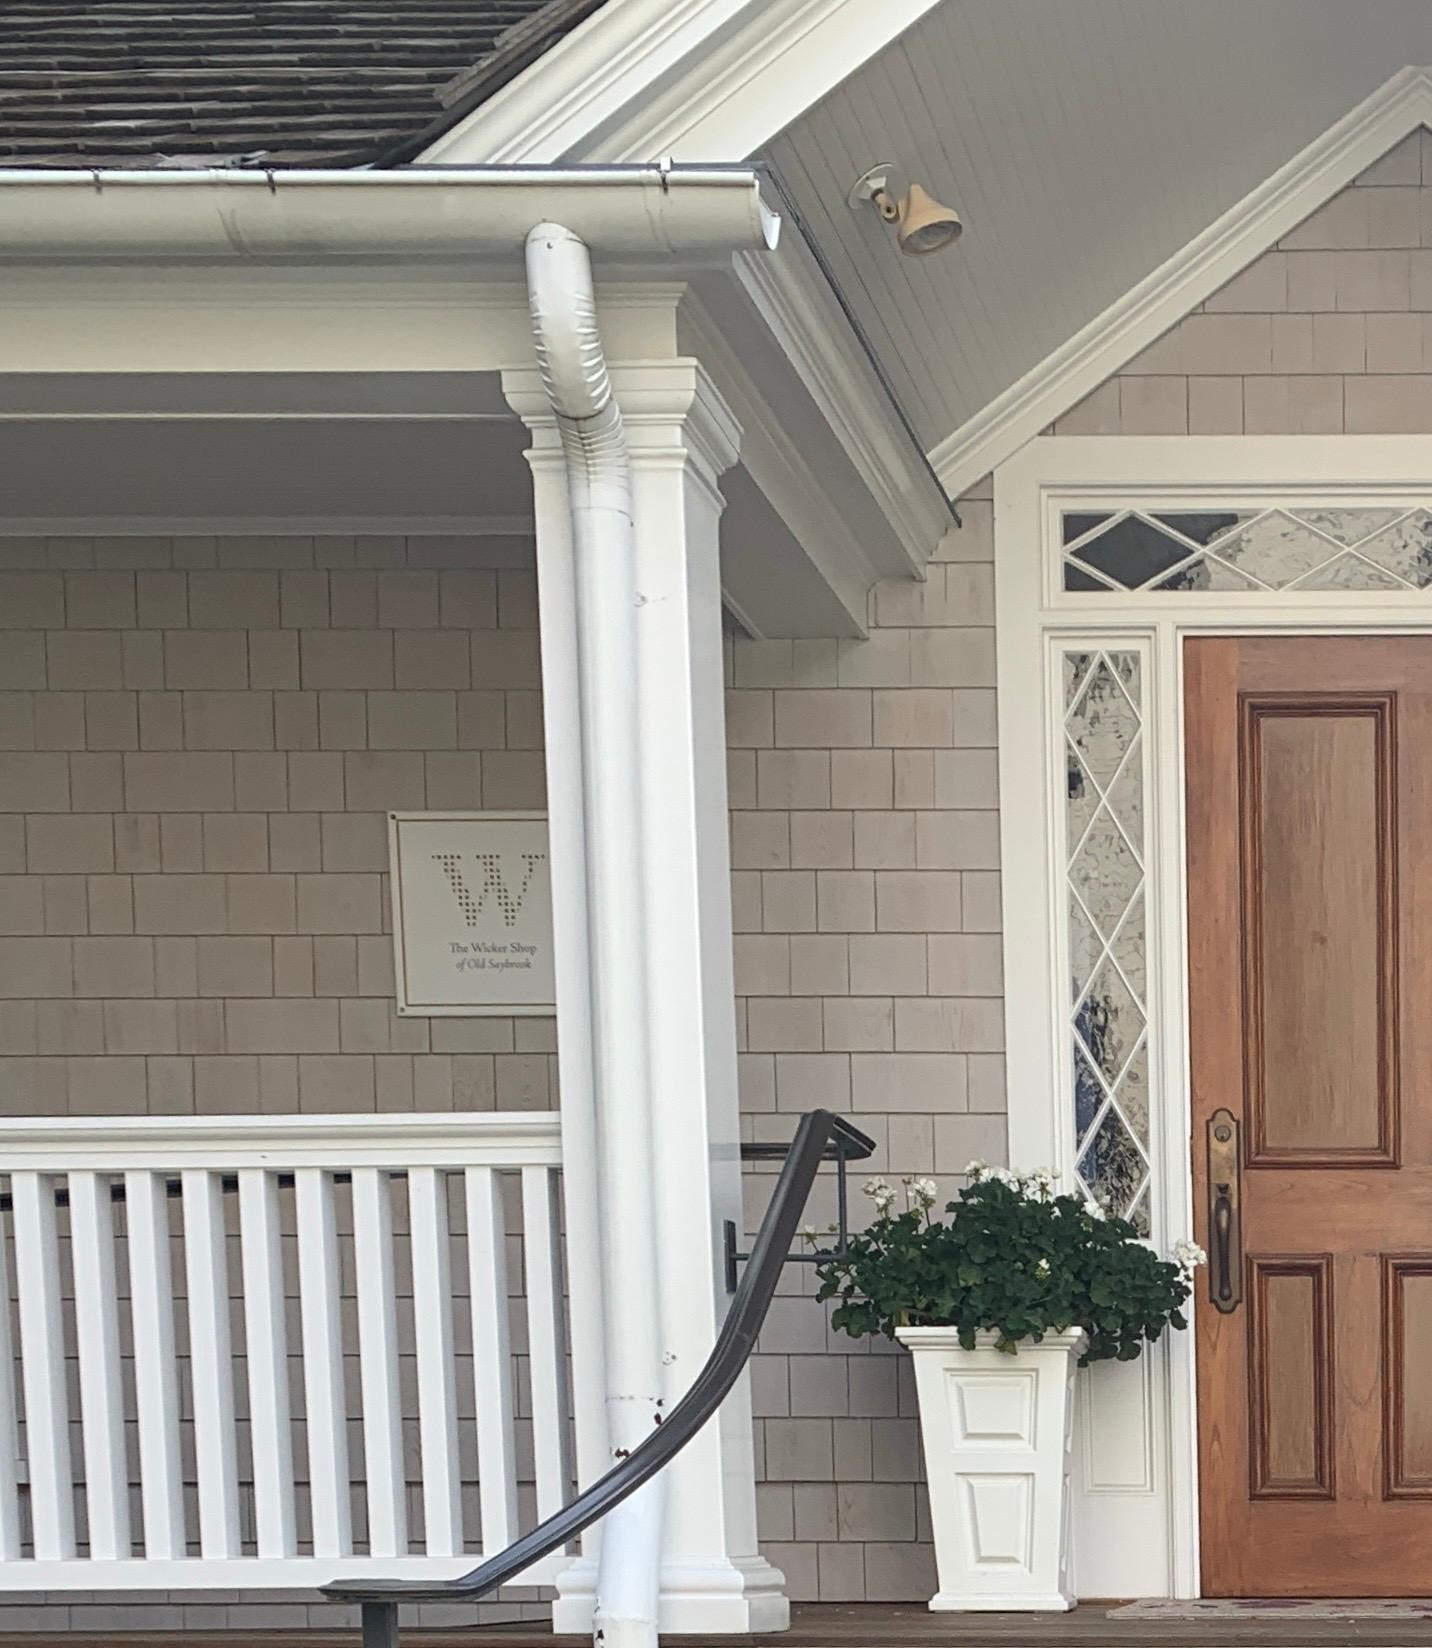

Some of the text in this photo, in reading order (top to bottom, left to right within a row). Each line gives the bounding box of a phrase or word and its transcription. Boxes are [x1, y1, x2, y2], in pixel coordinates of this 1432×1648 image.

[431, 854, 546, 927] W
[448, 942, 537, 956] The Wicker Shop
[456, 958, 532, 973] of Old Saybrook
